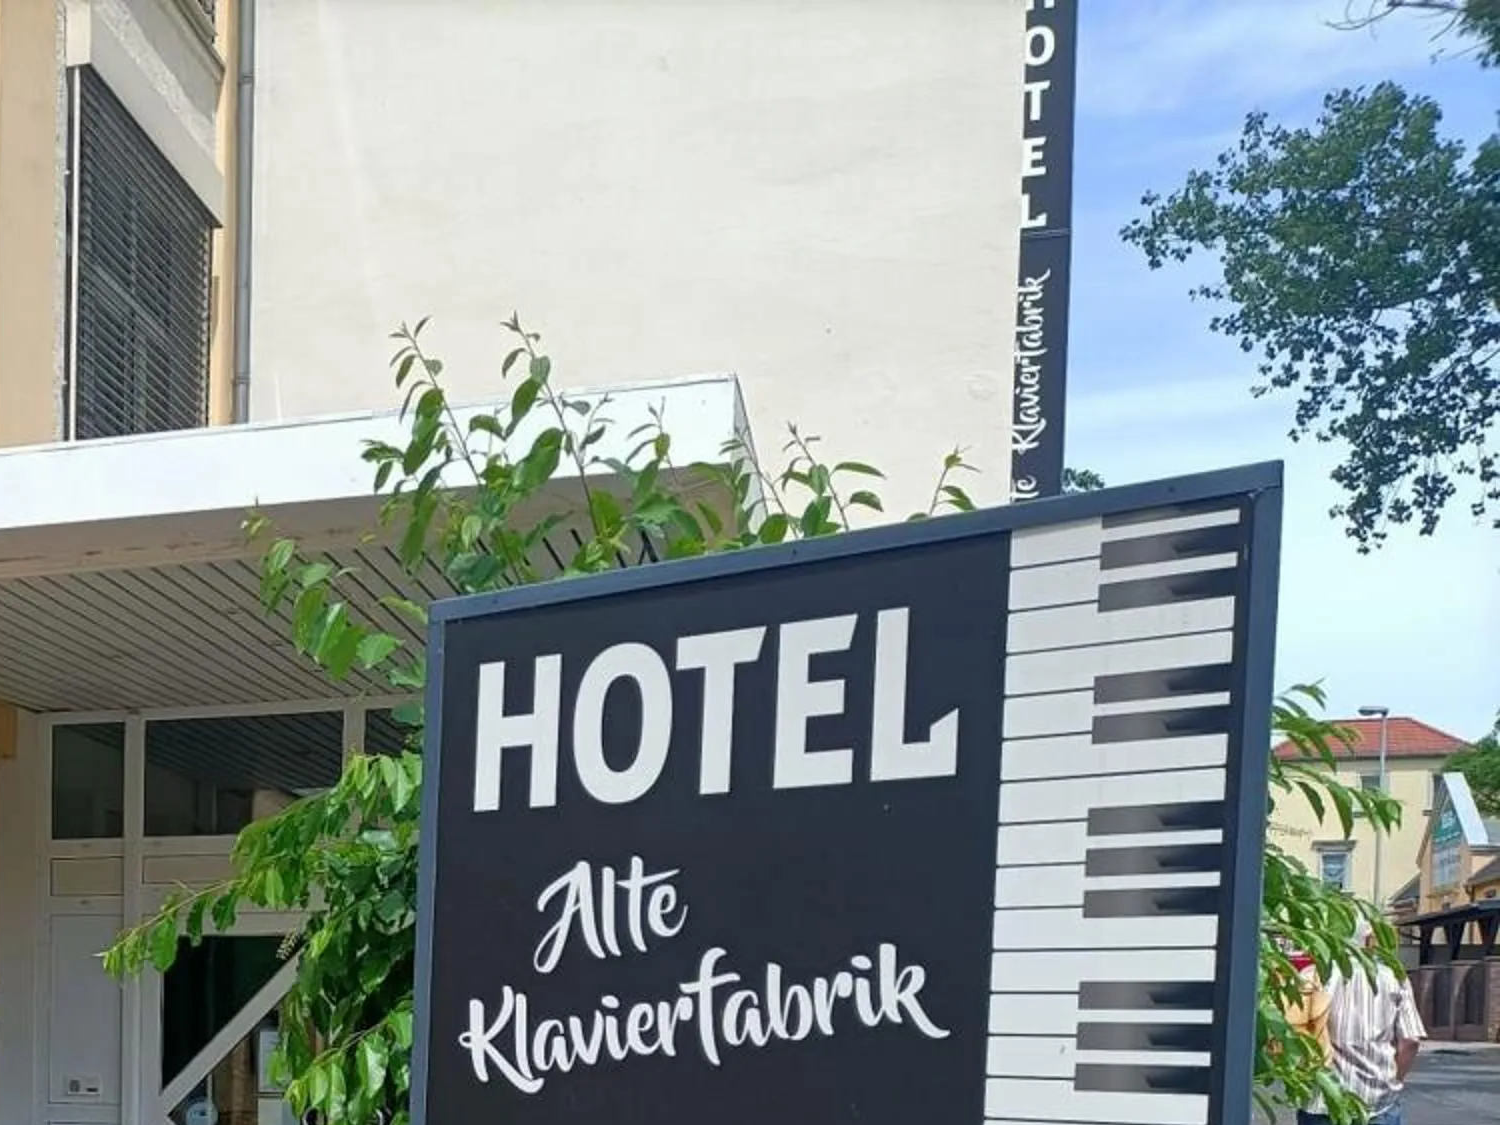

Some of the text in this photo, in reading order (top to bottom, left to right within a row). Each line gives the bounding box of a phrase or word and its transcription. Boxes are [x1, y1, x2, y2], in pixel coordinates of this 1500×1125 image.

[1020, 0, 1056, 230] OTEL
[1011, 268, 1051, 454] Klavierfabrik
[473, 607, 960, 813] HOTEL
[533, 855, 688, 973] Alte
[458, 943, 950, 1094] Klavierfabrik
